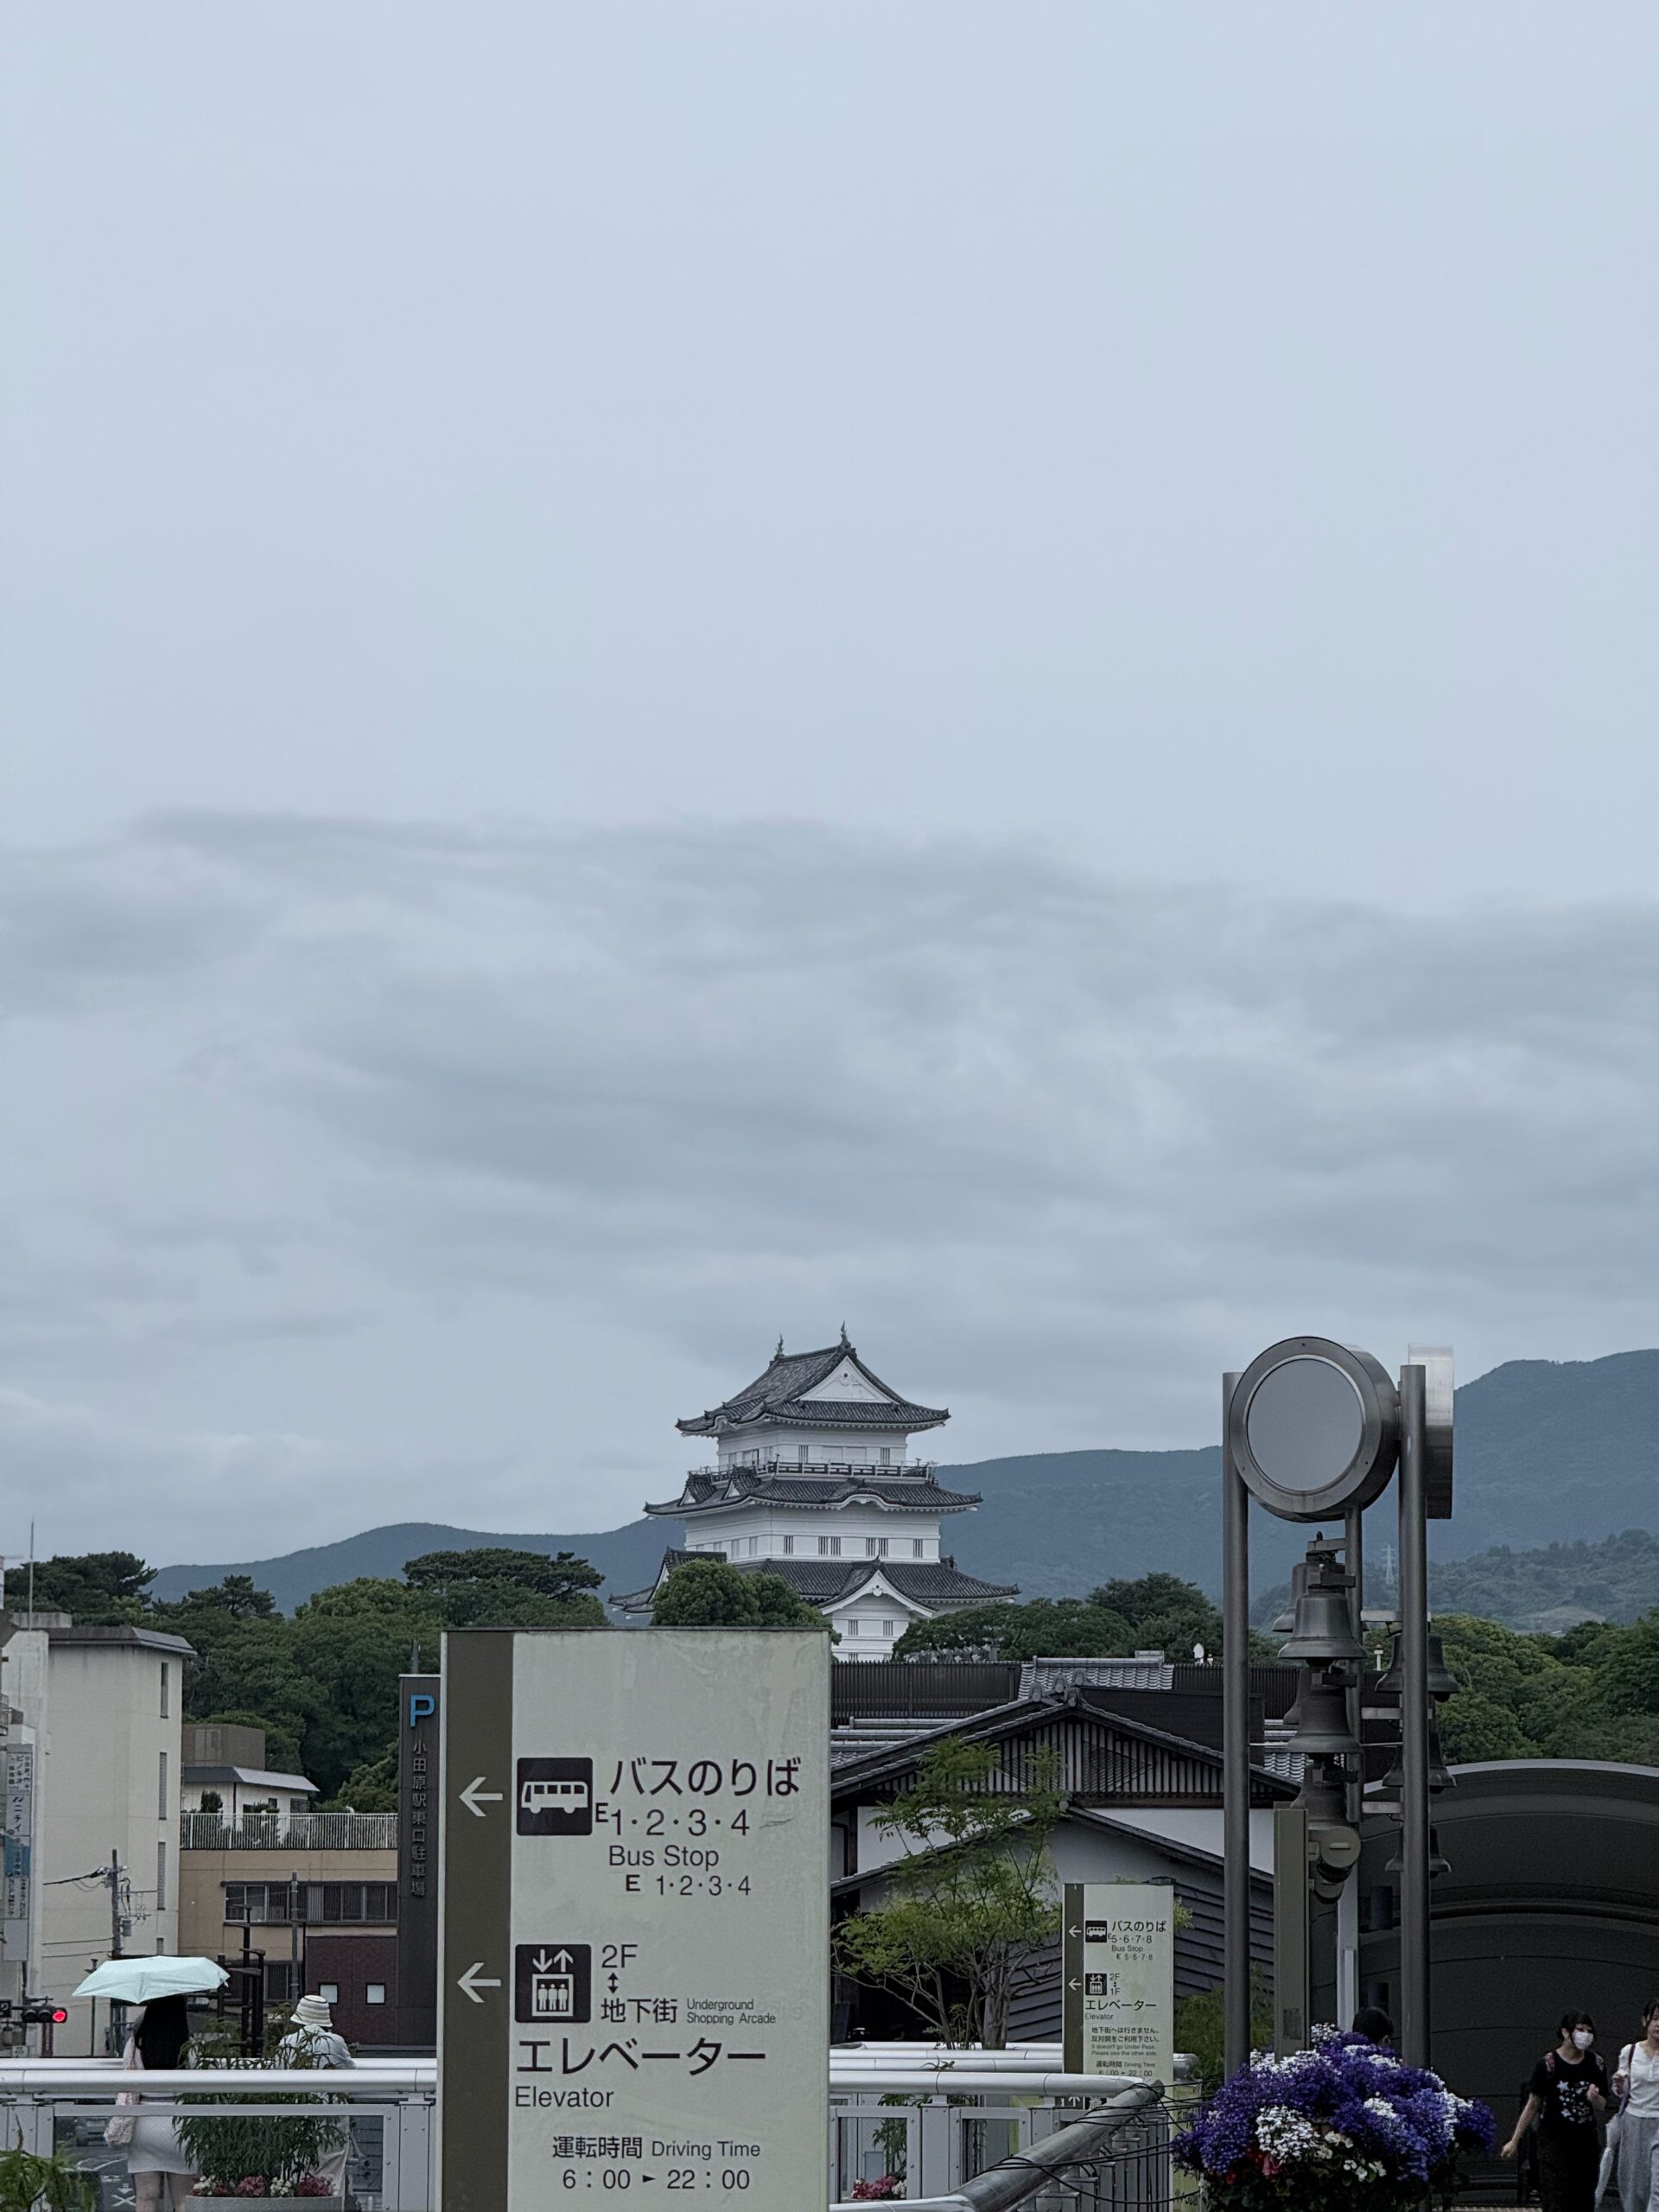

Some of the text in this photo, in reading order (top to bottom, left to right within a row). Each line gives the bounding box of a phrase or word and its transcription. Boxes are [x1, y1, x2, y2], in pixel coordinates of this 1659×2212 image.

[410, 1694, 435, 1727] P
[610, 1758, 801, 1796] バスのりば
[412, 1739, 427, 1897] 小田原駅東口駐車場
[610, 1845, 719, 1872] Bus Stop
[626, 1875, 640, 1891] E
[1112, 1921, 1166, 1932] バスのりば
[602, 1944, 638, 1967] 2F
[601, 1998, 677, 2023] 地下街
[687, 1999, 753, 2012] Underground
[1085, 2000, 1156, 2011] エレベーター
[687, 2012, 776, 2025] Shopping Arcade
[518, 2037, 766, 2075] エレベーター
[516, 2086, 613, 2107] Elevator
[553, 2136, 642, 2158] 運転時間
[652, 2141, 760, 2160] Driving Time
